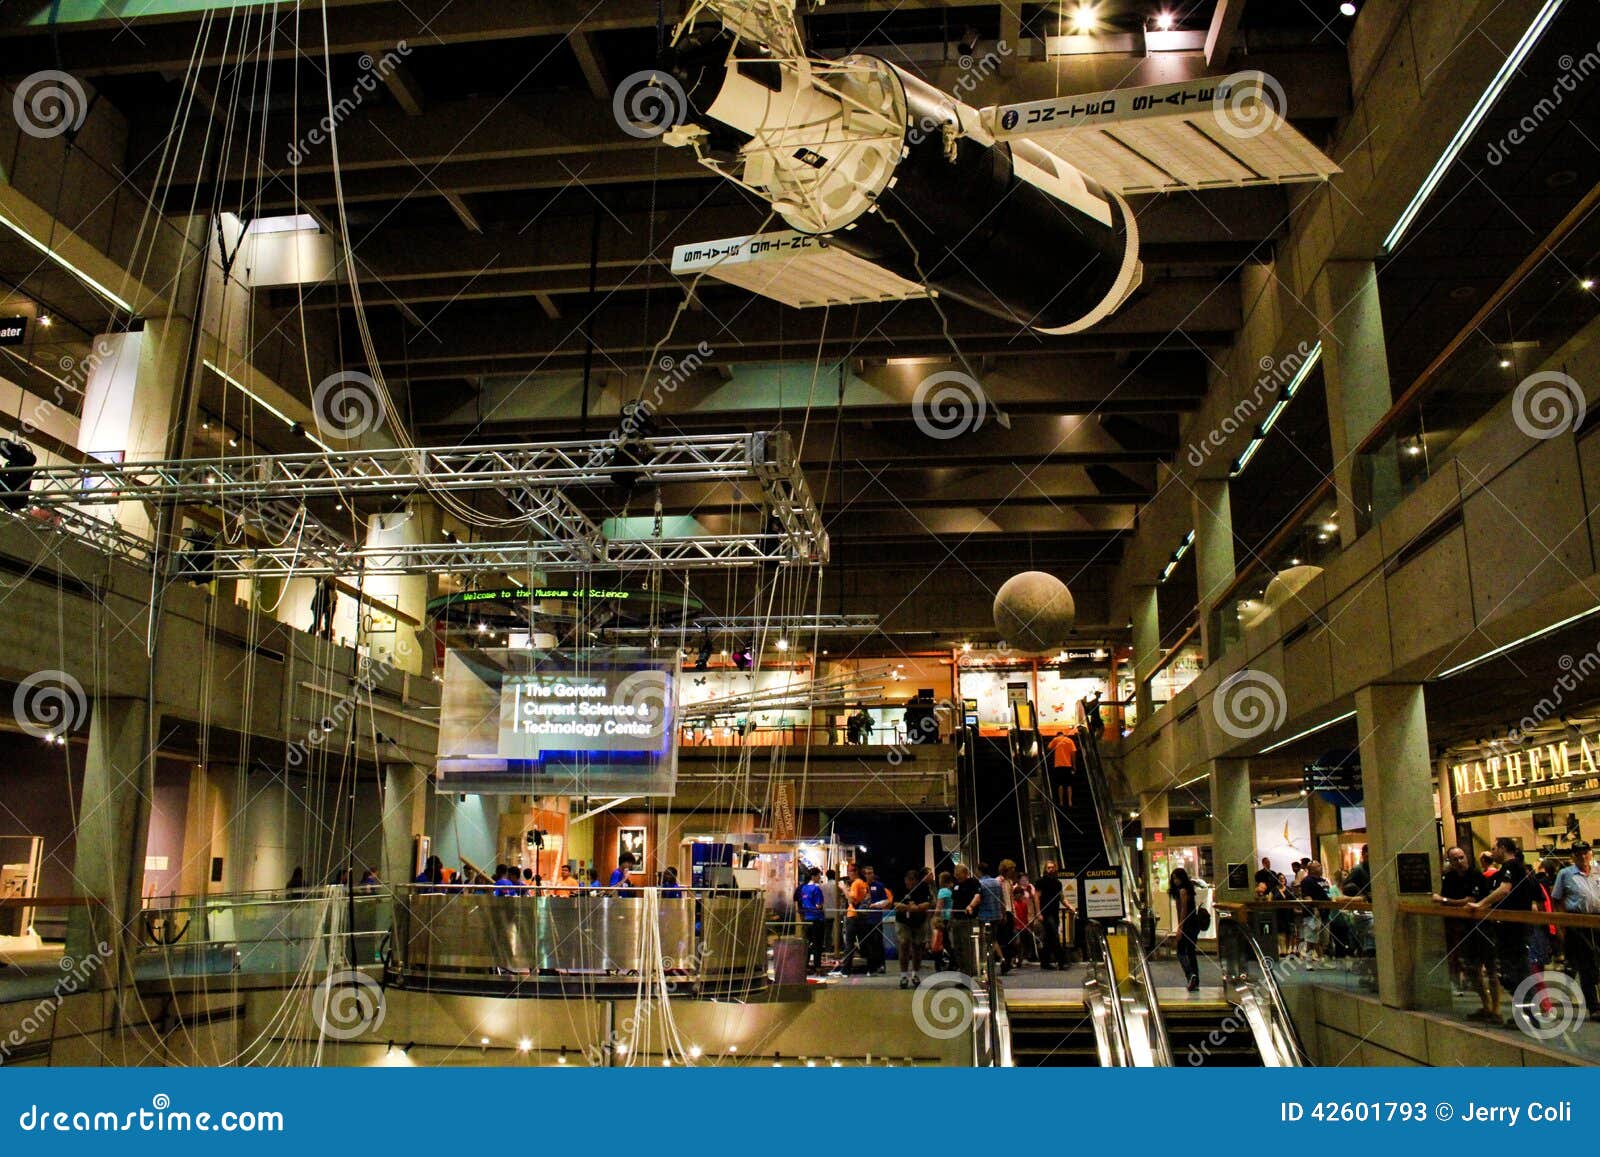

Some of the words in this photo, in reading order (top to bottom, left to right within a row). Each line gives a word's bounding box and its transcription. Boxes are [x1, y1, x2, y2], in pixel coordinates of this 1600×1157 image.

[1027, 100, 1115, 123] UNITED
[1132, 84, 1232, 111] STATES
[750, 236, 812, 254] UNITED
[463, 592, 497, 601] Welcome
[501, 590, 511, 598] to
[516, 590, 531, 598] the
[535, 590, 569, 598] Museum
[572, 589, 584, 598] of
[589, 589, 629, 599] Science
[525, 684, 551, 697] The
[553, 684, 606, 697] Gordon
[523, 702, 576, 716] Current
[579, 702, 635, 716] Science
[637, 703, 649, 716] &
[523, 721, 602, 736] Technology
[604, 721, 653, 735] Center
[1453, 735, 1600, 796] MATHEMA
[1086, 869, 1117, 878] CAUTION
